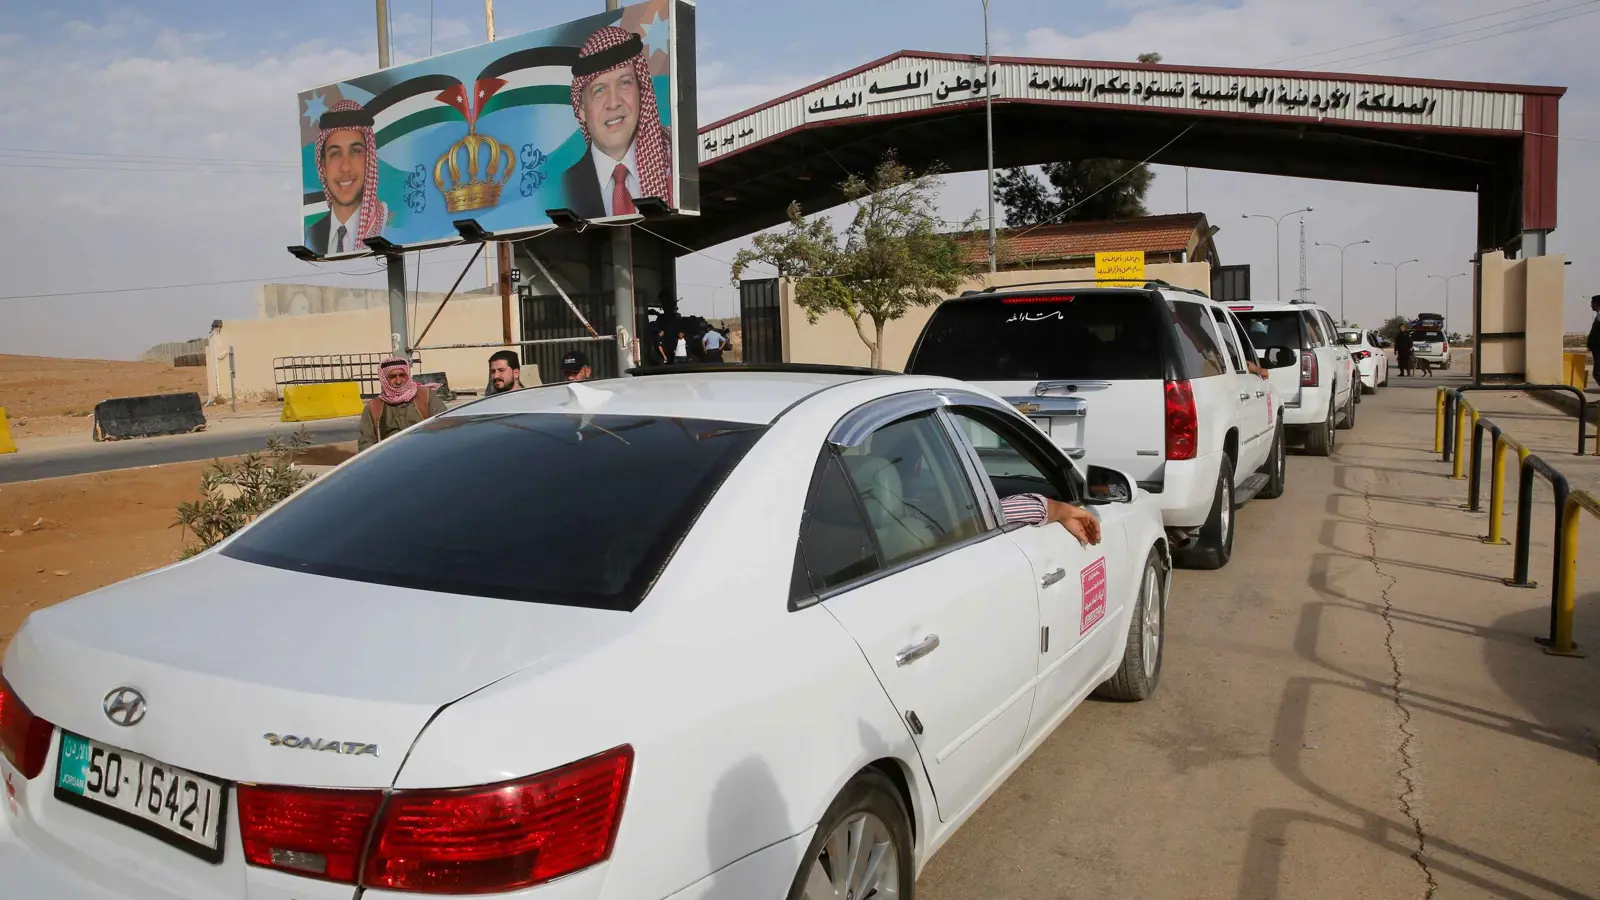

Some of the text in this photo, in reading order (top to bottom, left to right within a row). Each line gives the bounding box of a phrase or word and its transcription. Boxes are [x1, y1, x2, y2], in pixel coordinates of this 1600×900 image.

[808, 69, 997, 114] الوطن الله الملك
[1028, 72, 1092, 93] السلامة
[1191, 83, 1275, 108] الهاشمية
[1277, 84, 1350, 112] الأردنية
[1356, 90, 1437, 116] المملكة
[704, 128, 754, 152] مديرية
[263, 732, 380, 757] SONATA
[62, 773, 85, 789] JORDAN
